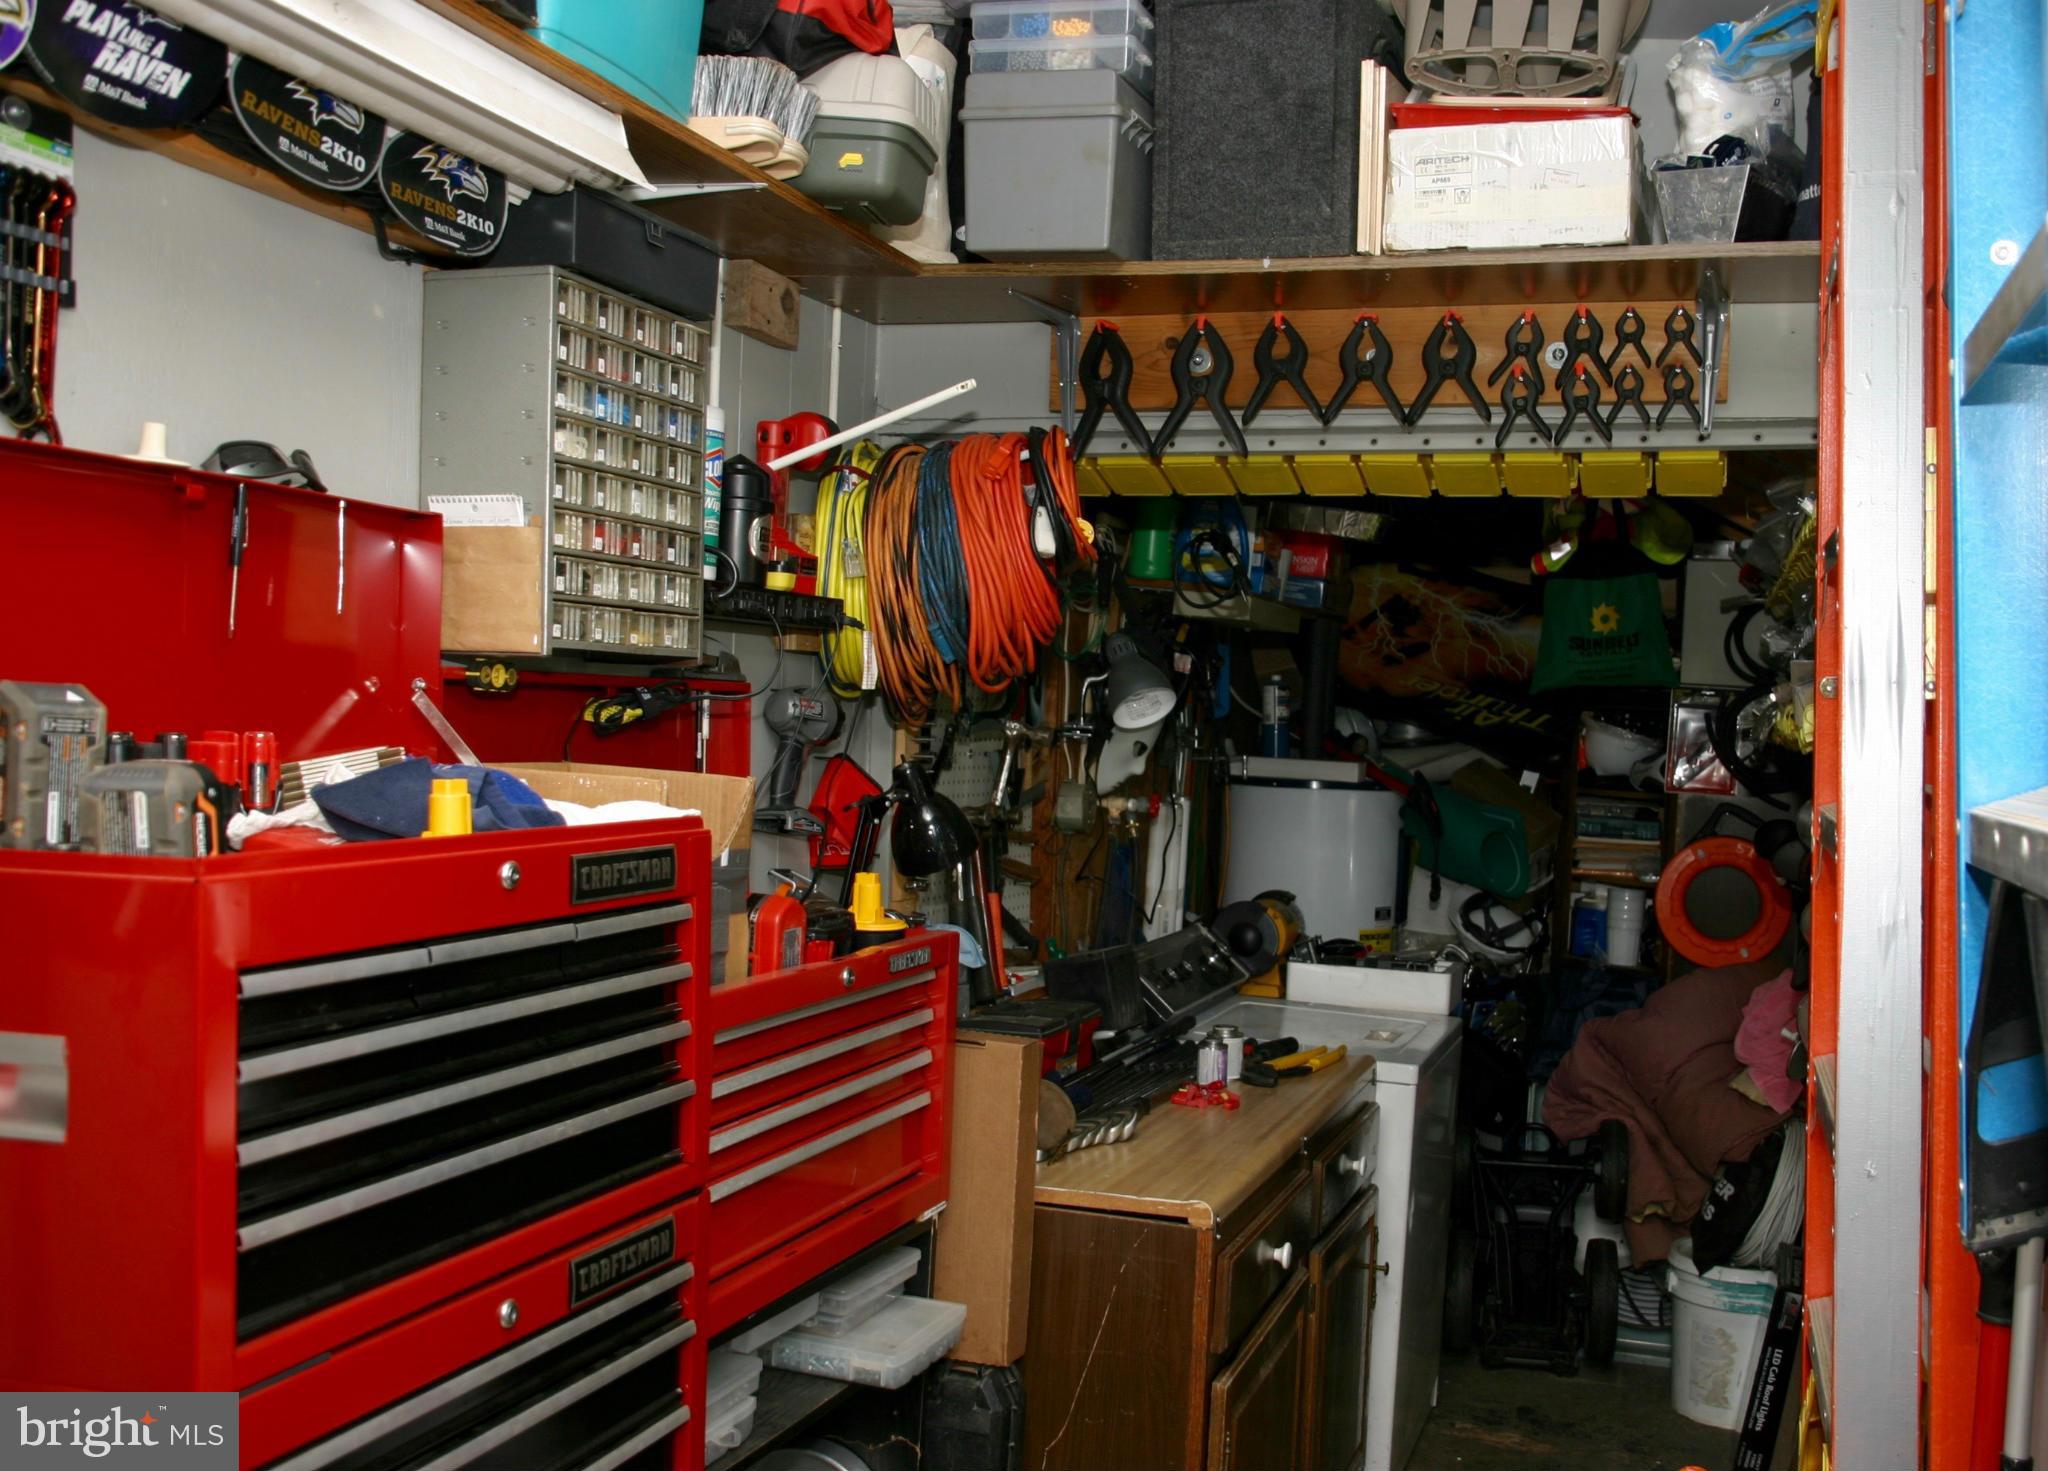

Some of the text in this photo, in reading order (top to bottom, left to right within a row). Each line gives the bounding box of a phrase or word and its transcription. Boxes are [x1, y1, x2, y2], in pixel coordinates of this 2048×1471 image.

[62, 0, 167, 59] PLAY LIKE A
[92, 40, 192, 99] RAVEN
[1415, 155, 1469, 166] ARITECH
[580, 856, 672, 891] CRAFTSMAN
[579, 1229, 671, 1293] CRAFTSMAN
[1754, 1348, 1784, 1432] LED Cab Roof Lights
